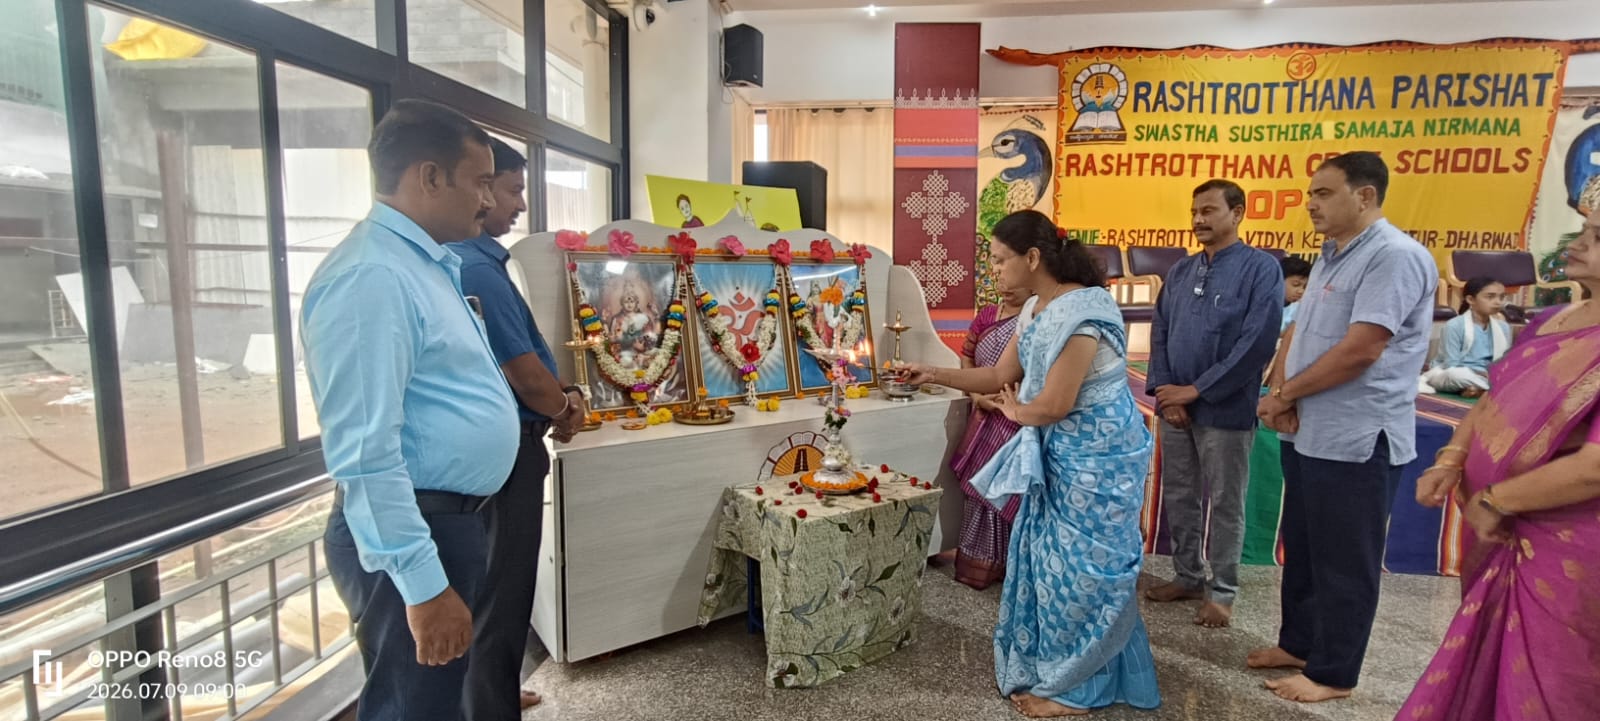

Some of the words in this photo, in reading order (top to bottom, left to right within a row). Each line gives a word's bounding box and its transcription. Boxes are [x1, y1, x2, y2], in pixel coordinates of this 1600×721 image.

[1132, 76, 1376, 115] RASHTROTTHANA
[1391, 73, 1554, 109] PARISHAT
[1134, 124, 1219, 143] SWASTHA
[1229, 122, 1324, 143] SUSTHIRA
[1333, 120, 1416, 139] SAMAJA
[1423, 117, 1521, 138] NIRMANA
[1065, 153, 1294, 179] RASHTROTTHANA
[1394, 147, 1533, 175] SCHOOLS
[1246, 230, 1295, 249] VIDYA
